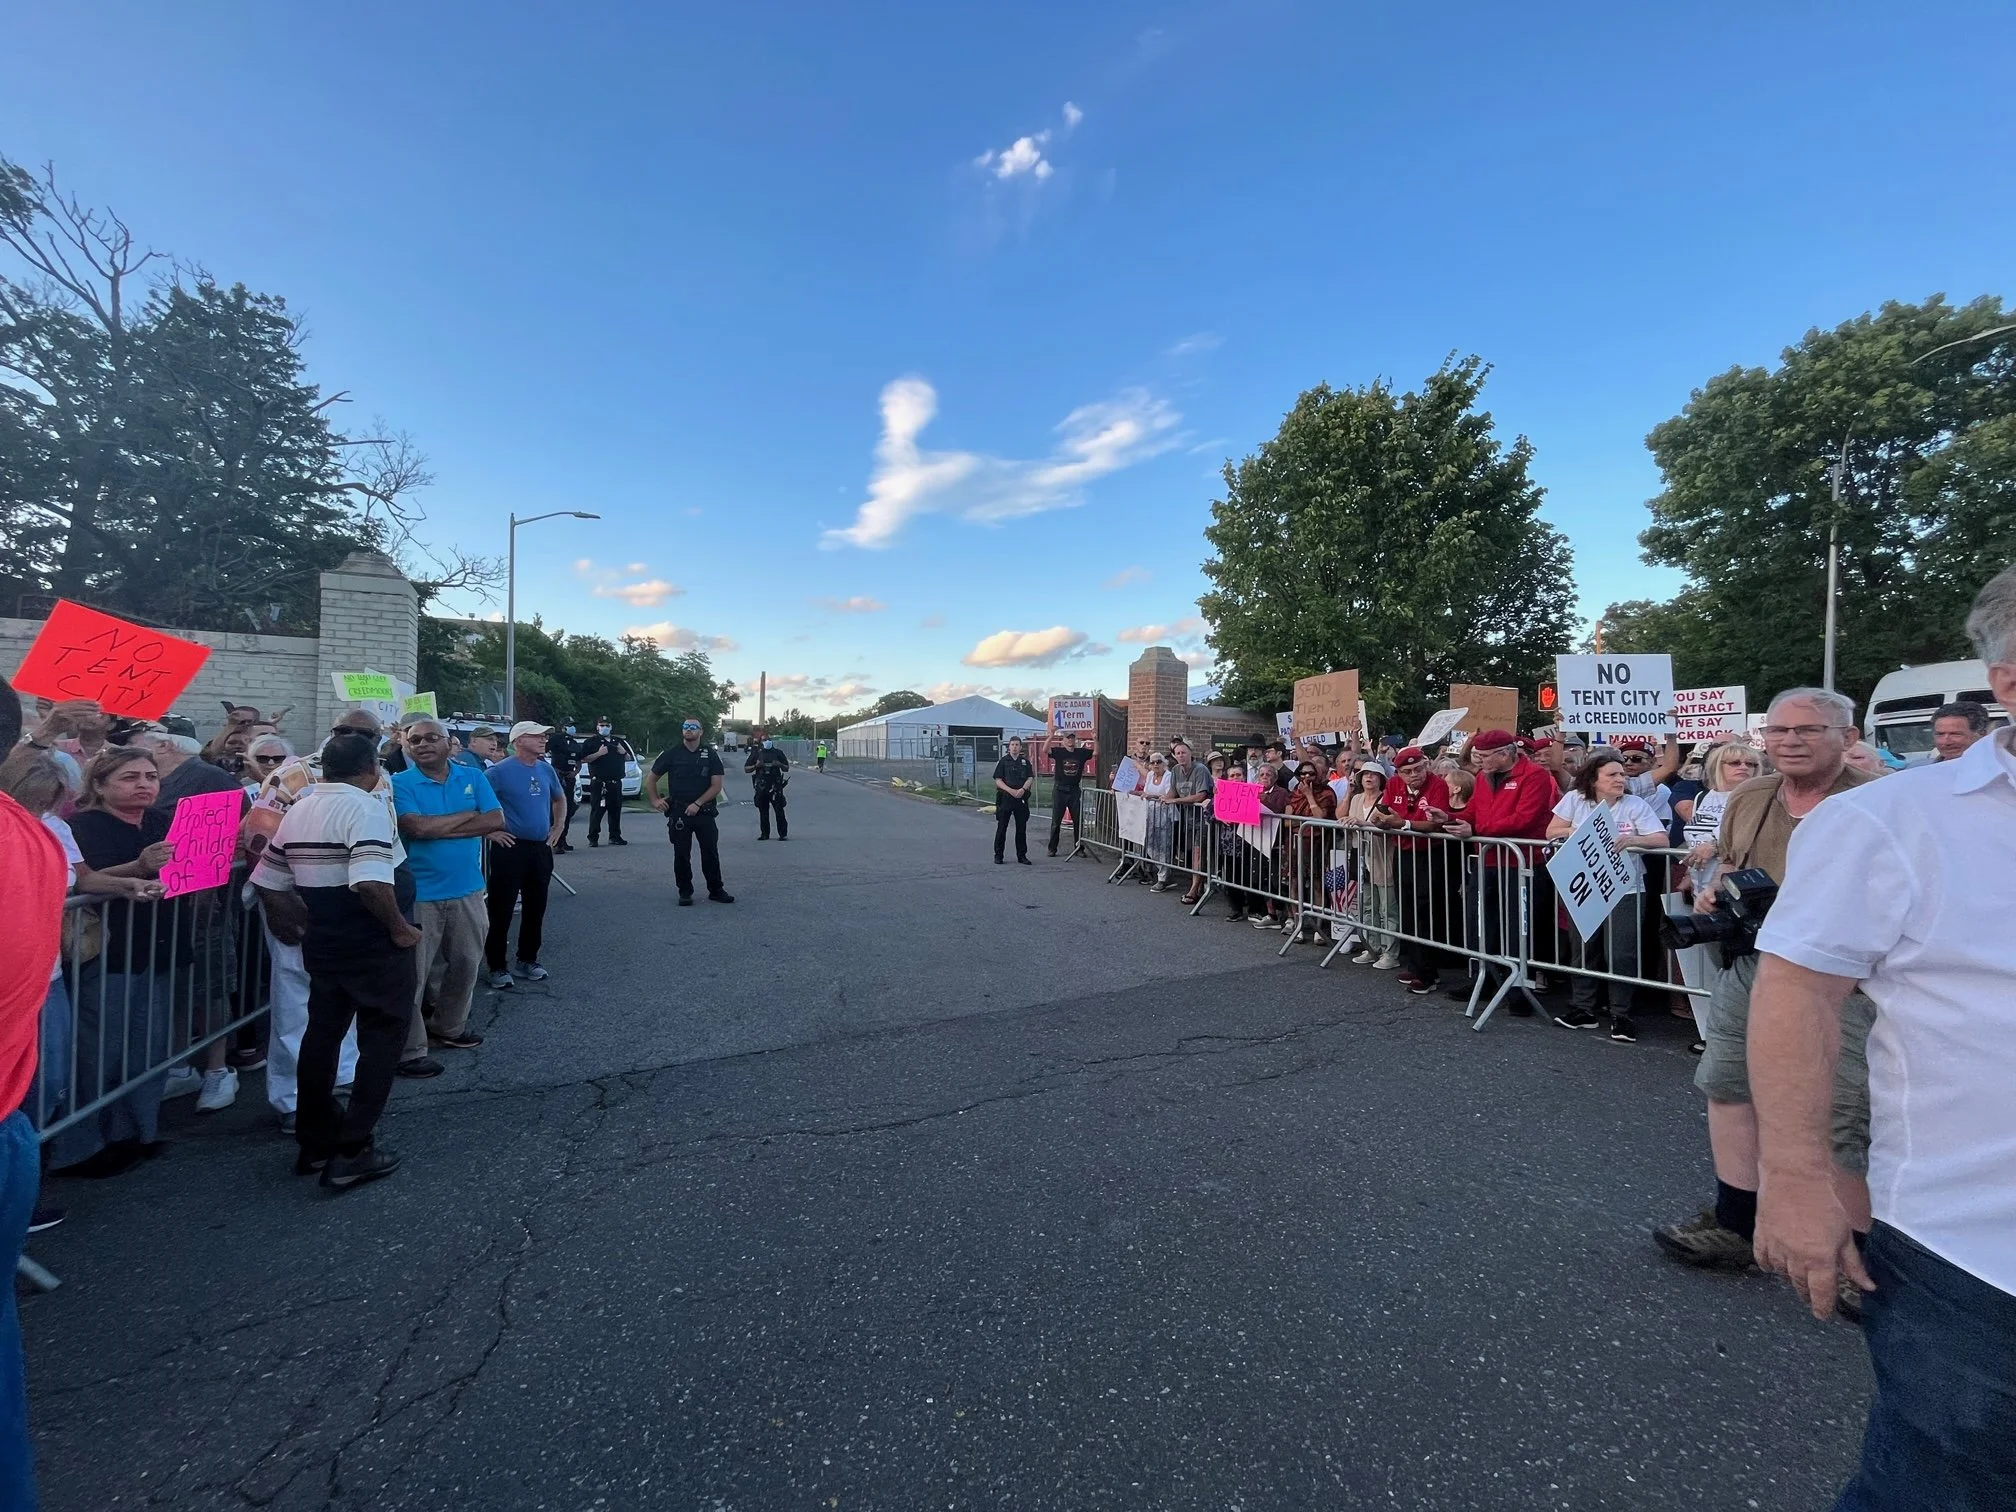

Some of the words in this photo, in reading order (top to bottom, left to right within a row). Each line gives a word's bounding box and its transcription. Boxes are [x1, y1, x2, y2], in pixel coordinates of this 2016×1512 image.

[85, 628, 163, 662] NO
[55, 646, 171, 687] TENT
[1597, 663, 1631, 685] NO
[57, 675, 153, 710] CITY
[1298, 682, 1332, 698] SEND
[1571, 690, 1616, 706] TENT
[1620, 690, 1661, 706] CITY
[1700, 690, 1726, 700] SAY
[378, 701, 400, 716] CITY
[1070, 700, 1091, 708] ADAMS
[1055, 710, 1064, 729] 1
[1062, 710, 1085, 719] Term
[1064, 720, 1093, 729] MAYOR
[1569, 714, 1581, 724] at
[1585, 711, 1667, 725] CREEDMOOR
[1697, 717, 1723, 727] SAY
[177, 795, 231, 832] Protect
[1577, 834, 1600, 868] CITY
[1592, 813, 1625, 876] CREEDMOOR
[1569, 871, 1593, 908] NO
[1592, 864, 1616, 903] TENT
